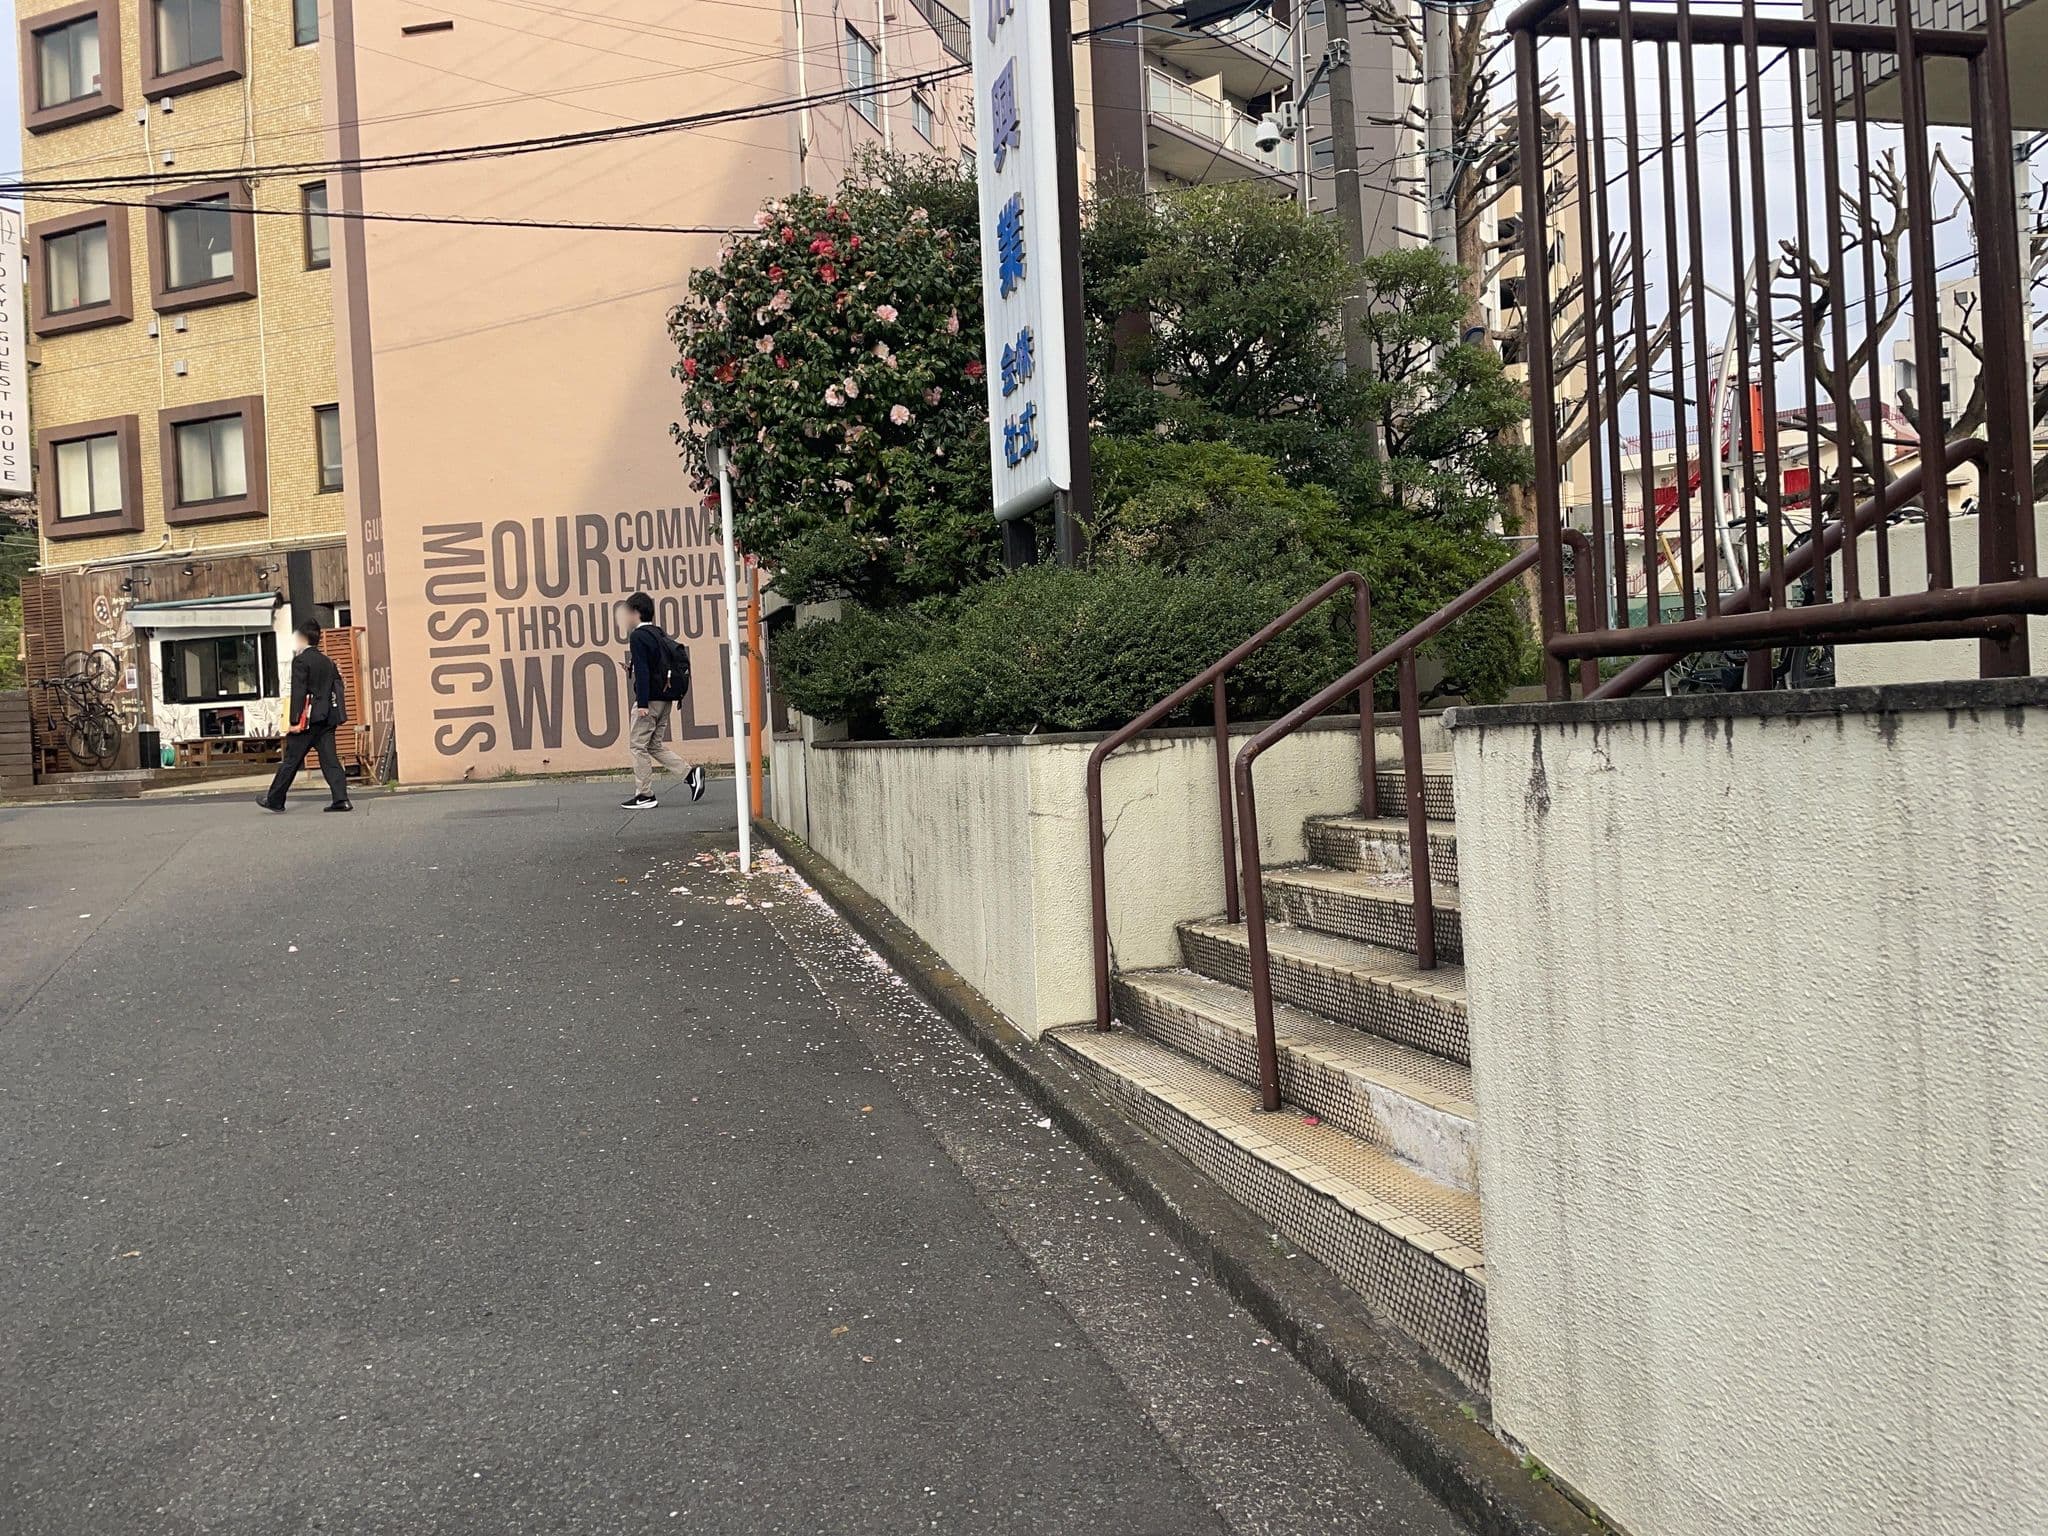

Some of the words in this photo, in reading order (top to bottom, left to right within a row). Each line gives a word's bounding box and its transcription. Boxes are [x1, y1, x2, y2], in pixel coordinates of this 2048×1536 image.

[0, 332, 11, 400] GUEST
[1, 410, 15, 480] HOUSE
[492, 513, 612, 600] OUR
[422, 522, 493, 694] MUSIC
[433, 705, 496, 756] IS
[500, 643, 767, 750] WOLD
